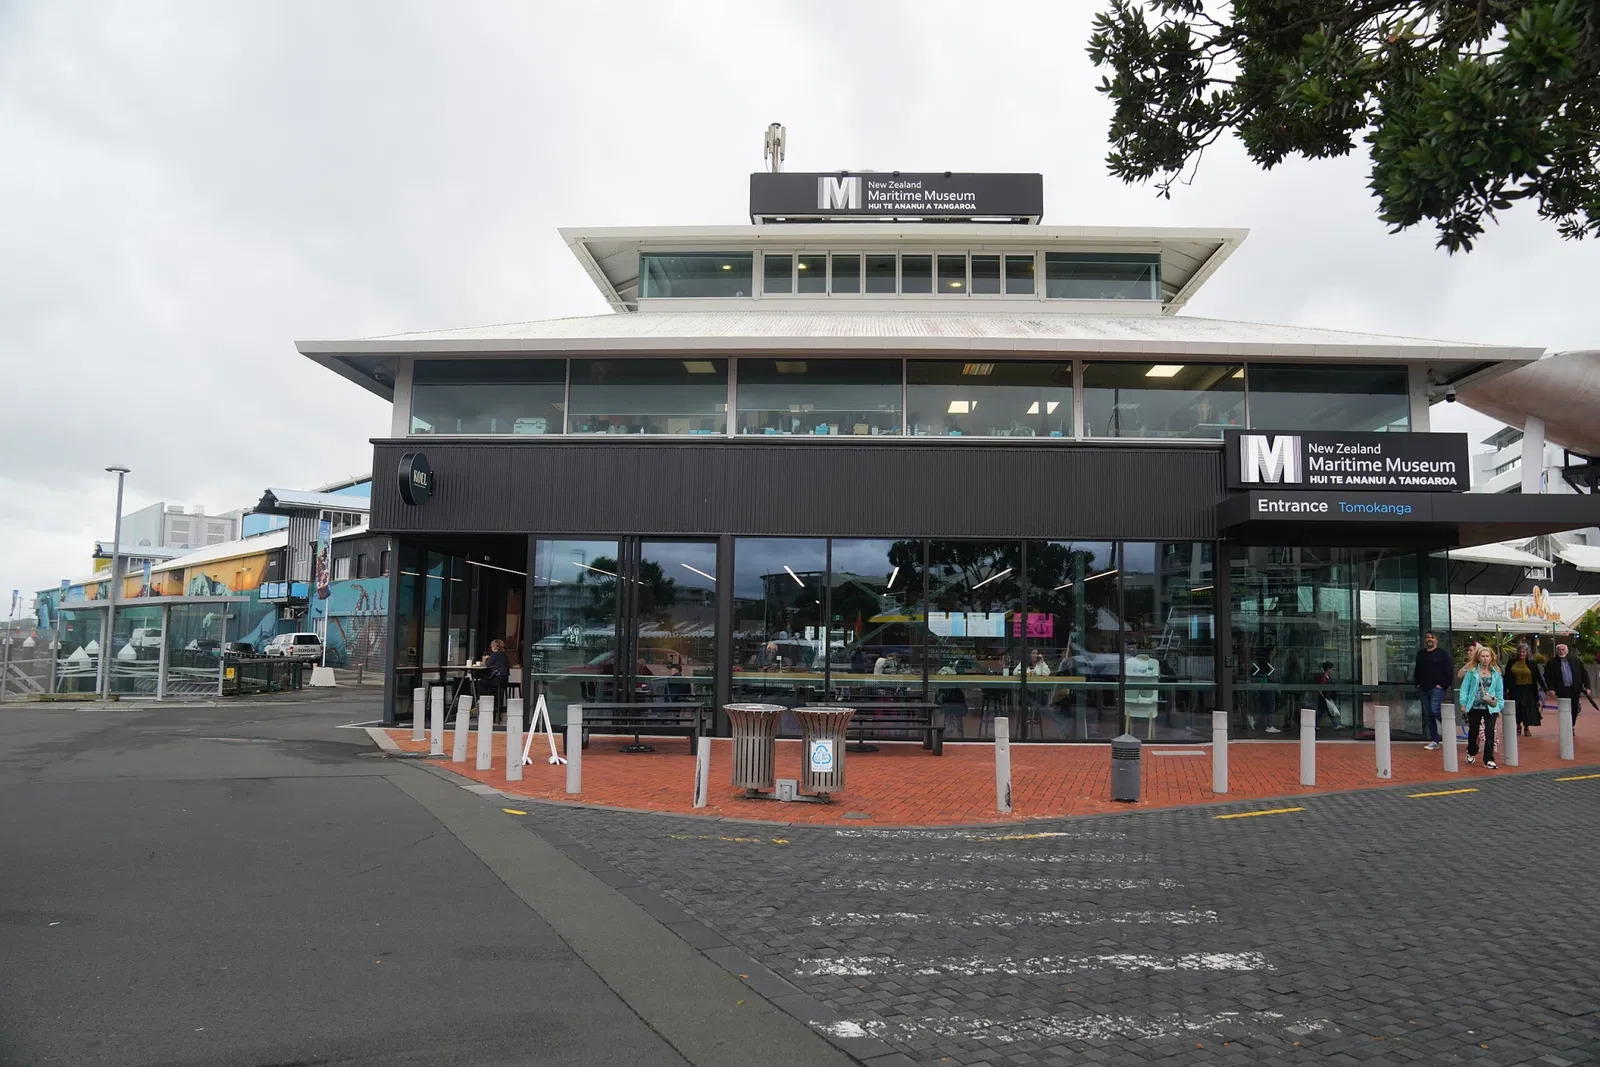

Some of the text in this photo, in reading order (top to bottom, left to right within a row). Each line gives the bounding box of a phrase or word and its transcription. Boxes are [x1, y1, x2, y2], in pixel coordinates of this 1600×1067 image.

[868, 180, 922, 189] New Zealand
[868, 190, 976, 201] Maritime Museum
[1308, 442, 1381, 455] New Zealand
[1240, 434, 1303, 484] M
[1309, 456, 1456, 473] Maritime Museum
[1309, 475, 1458, 486] HUI TE ANANUI A TANGAROA
[1257, 499, 1412, 515] Entrance Tomokanga
